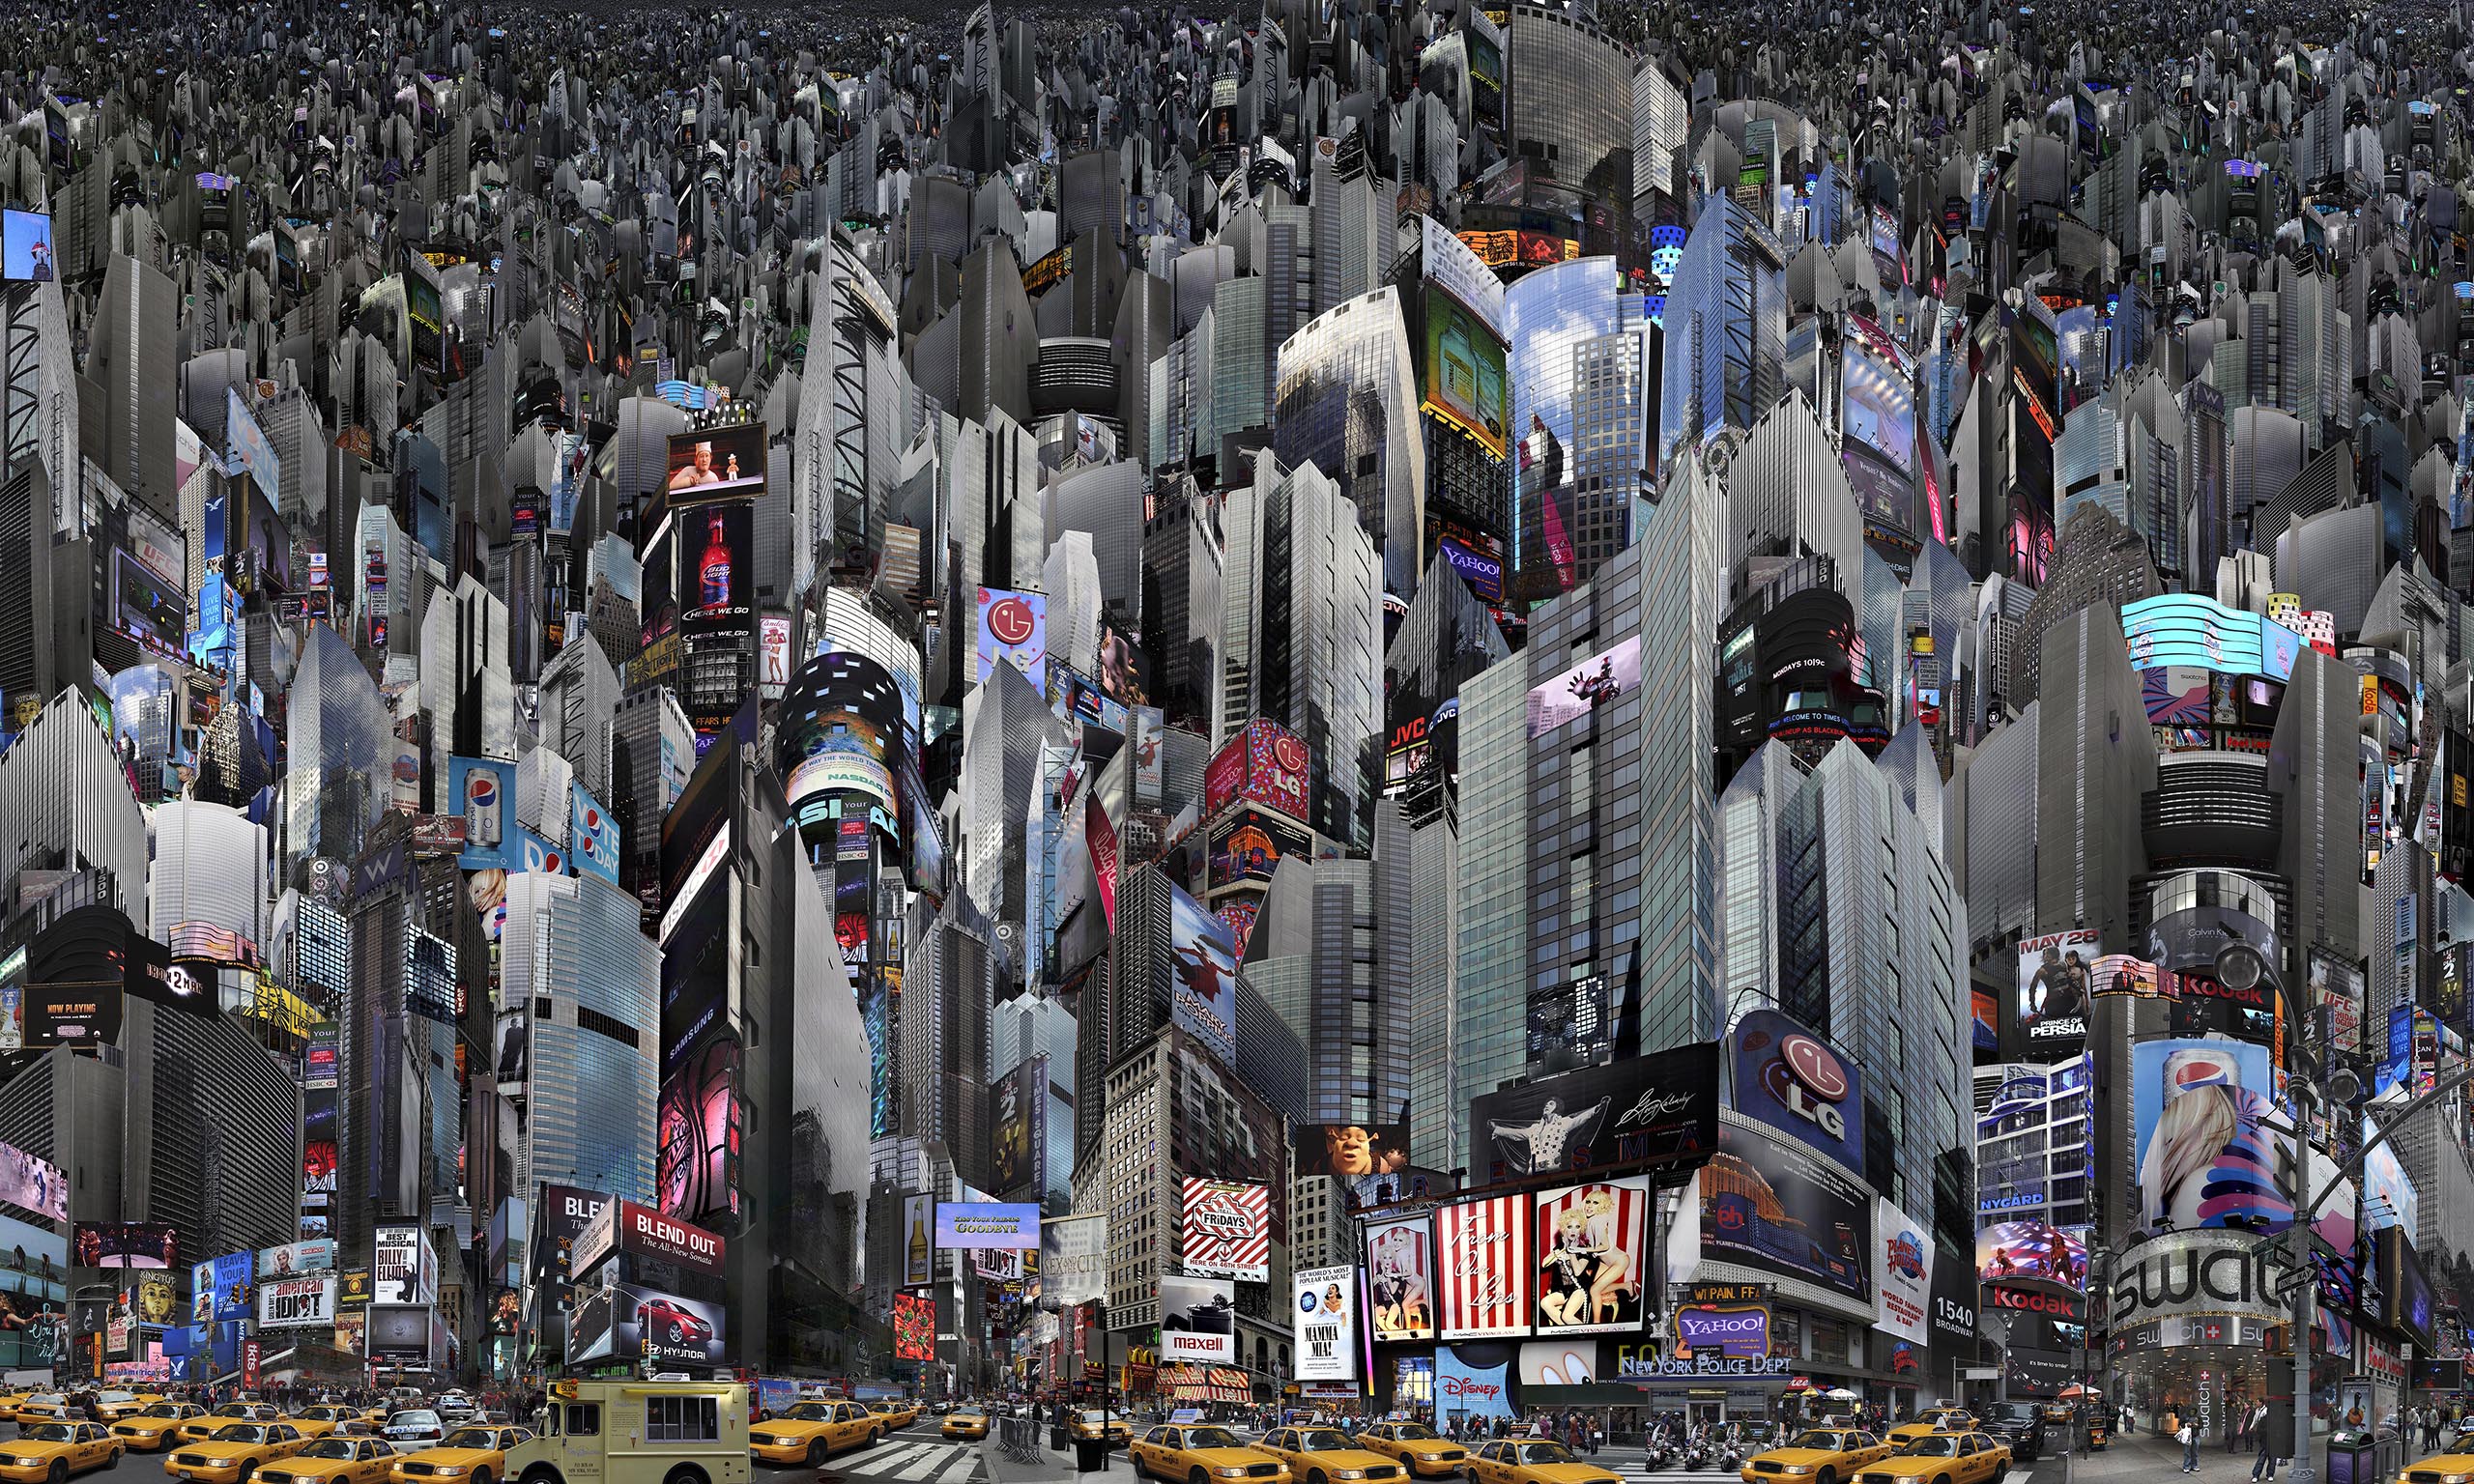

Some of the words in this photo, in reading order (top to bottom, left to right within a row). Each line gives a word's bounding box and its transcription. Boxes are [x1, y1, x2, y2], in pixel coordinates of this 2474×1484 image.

[1443, 546, 1500, 578] YAHOO!
[205, 594, 219, 607] LIVE
[202, 606, 219, 617] YOUR
[206, 616, 219, 626] LIFE
[691, 610, 713, 619] HERE
[734, 607, 749, 615] GO
[691, 633, 713, 642] HERE
[1437, 708, 1455, 723] JVC
[1391, 717, 1424, 747] JVC
[839, 755, 863, 763] WORLD
[828, 773, 882, 790] NASDAQ
[1275, 769, 1301, 798] LG
[2402, 896, 2410, 938] OUTFITTERS
[2020, 934, 2064, 955] MAY
[2067, 929, 2099, 946] 28
[147, 963, 171, 984] IRON
[174, 972, 182, 988] 2
[47, 1004, 64, 1013] NOW
[66, 1003, 96, 1013] PLAYING
[1175, 991, 1234, 1043] POPPINS
[1186, 993, 1227, 1029] MARY
[670, 1008, 714, 1060] SAMSUNG
[1177, 1007, 1191, 1018] ON
[1194, 1019, 1233, 1051] BROADWAY
[2030, 1023, 2086, 1038] PERSIA
[2394, 1020, 2407, 1032] LIVE
[2391, 1033, 2408, 1044] YOUR
[2396, 1044, 2408, 1054] LIFE
[1000, 1071, 1018, 1087] LEFT
[1034, 1068, 1043, 1121] TIMES
[999, 1096, 1016, 1121] 2
[1788, 1084, 1845, 1143] LG
[1033, 1122, 1043, 1183] SQUARE
[637, 1213, 685, 1245] BLEND
[955, 1223, 1018, 1233] GOODBYE
[1450, 1213, 1510, 1248] From
[378, 1249, 402, 1265] BILLY
[642, 1235, 657, 1247] The
[658, 1242, 688, 1257] All-New
[689, 1252, 712, 1266] Sonata
[1886, 1240, 1916, 1260] PLANET
[2280, 1253, 2292, 1264] ONE
[219, 1256, 245, 1269] LEAVE
[1044, 1257, 1062, 1275] SEX
[1078, 1254, 1106, 1273] CITY
[1454, 1250, 1489, 1277] Our
[1887, 1254, 1927, 1281] HOLLYWOOD
[141, 1270, 158, 1281] KING
[161, 1274, 176, 1286] TUT
[221, 1269, 244, 1279] YOUR
[378, 1266, 406, 1281] ELLIOT
[2281, 1277, 2291, 1287] ONE
[2297, 1270, 2311, 1280] WAY
[276, 1280, 323, 1296] american
[1468, 1273, 1517, 1316] Lips
[276, 1293, 323, 1319] IDIOT
[1882, 1289, 1903, 1304] WORLD
[1905, 1300, 1924, 1317] FAMOUS
[1995, 1286, 2075, 1317] Kodak
[1886, 1301, 1920, 1323] RESTAURANT
[1937, 1297, 1972, 1327] 1540
[1682, 1317, 1765, 1336] YAHOO!
[1902, 1318, 1913, 1327] BAR
[1936, 1318, 1973, 1338] BROADWAY
[1174, 1336, 1223, 1351] maxell
[1305, 1326, 1338, 1342] MAMMA
[247, 1344, 256, 1371] tkts
[664, 1347, 705, 1359] HYUNDAI
[1311, 1342, 1332, 1356] MIA!
[2369, 1347, 2386, 1370] Foot
[1622, 1356, 1654, 1375] NEW
[1655, 1354, 1693, 1374] YORK
[1697, 1354, 1746, 1375] POLICE
[1753, 1353, 1791, 1373] DEPT
[2199, 1382, 2209, 1437] swatch
